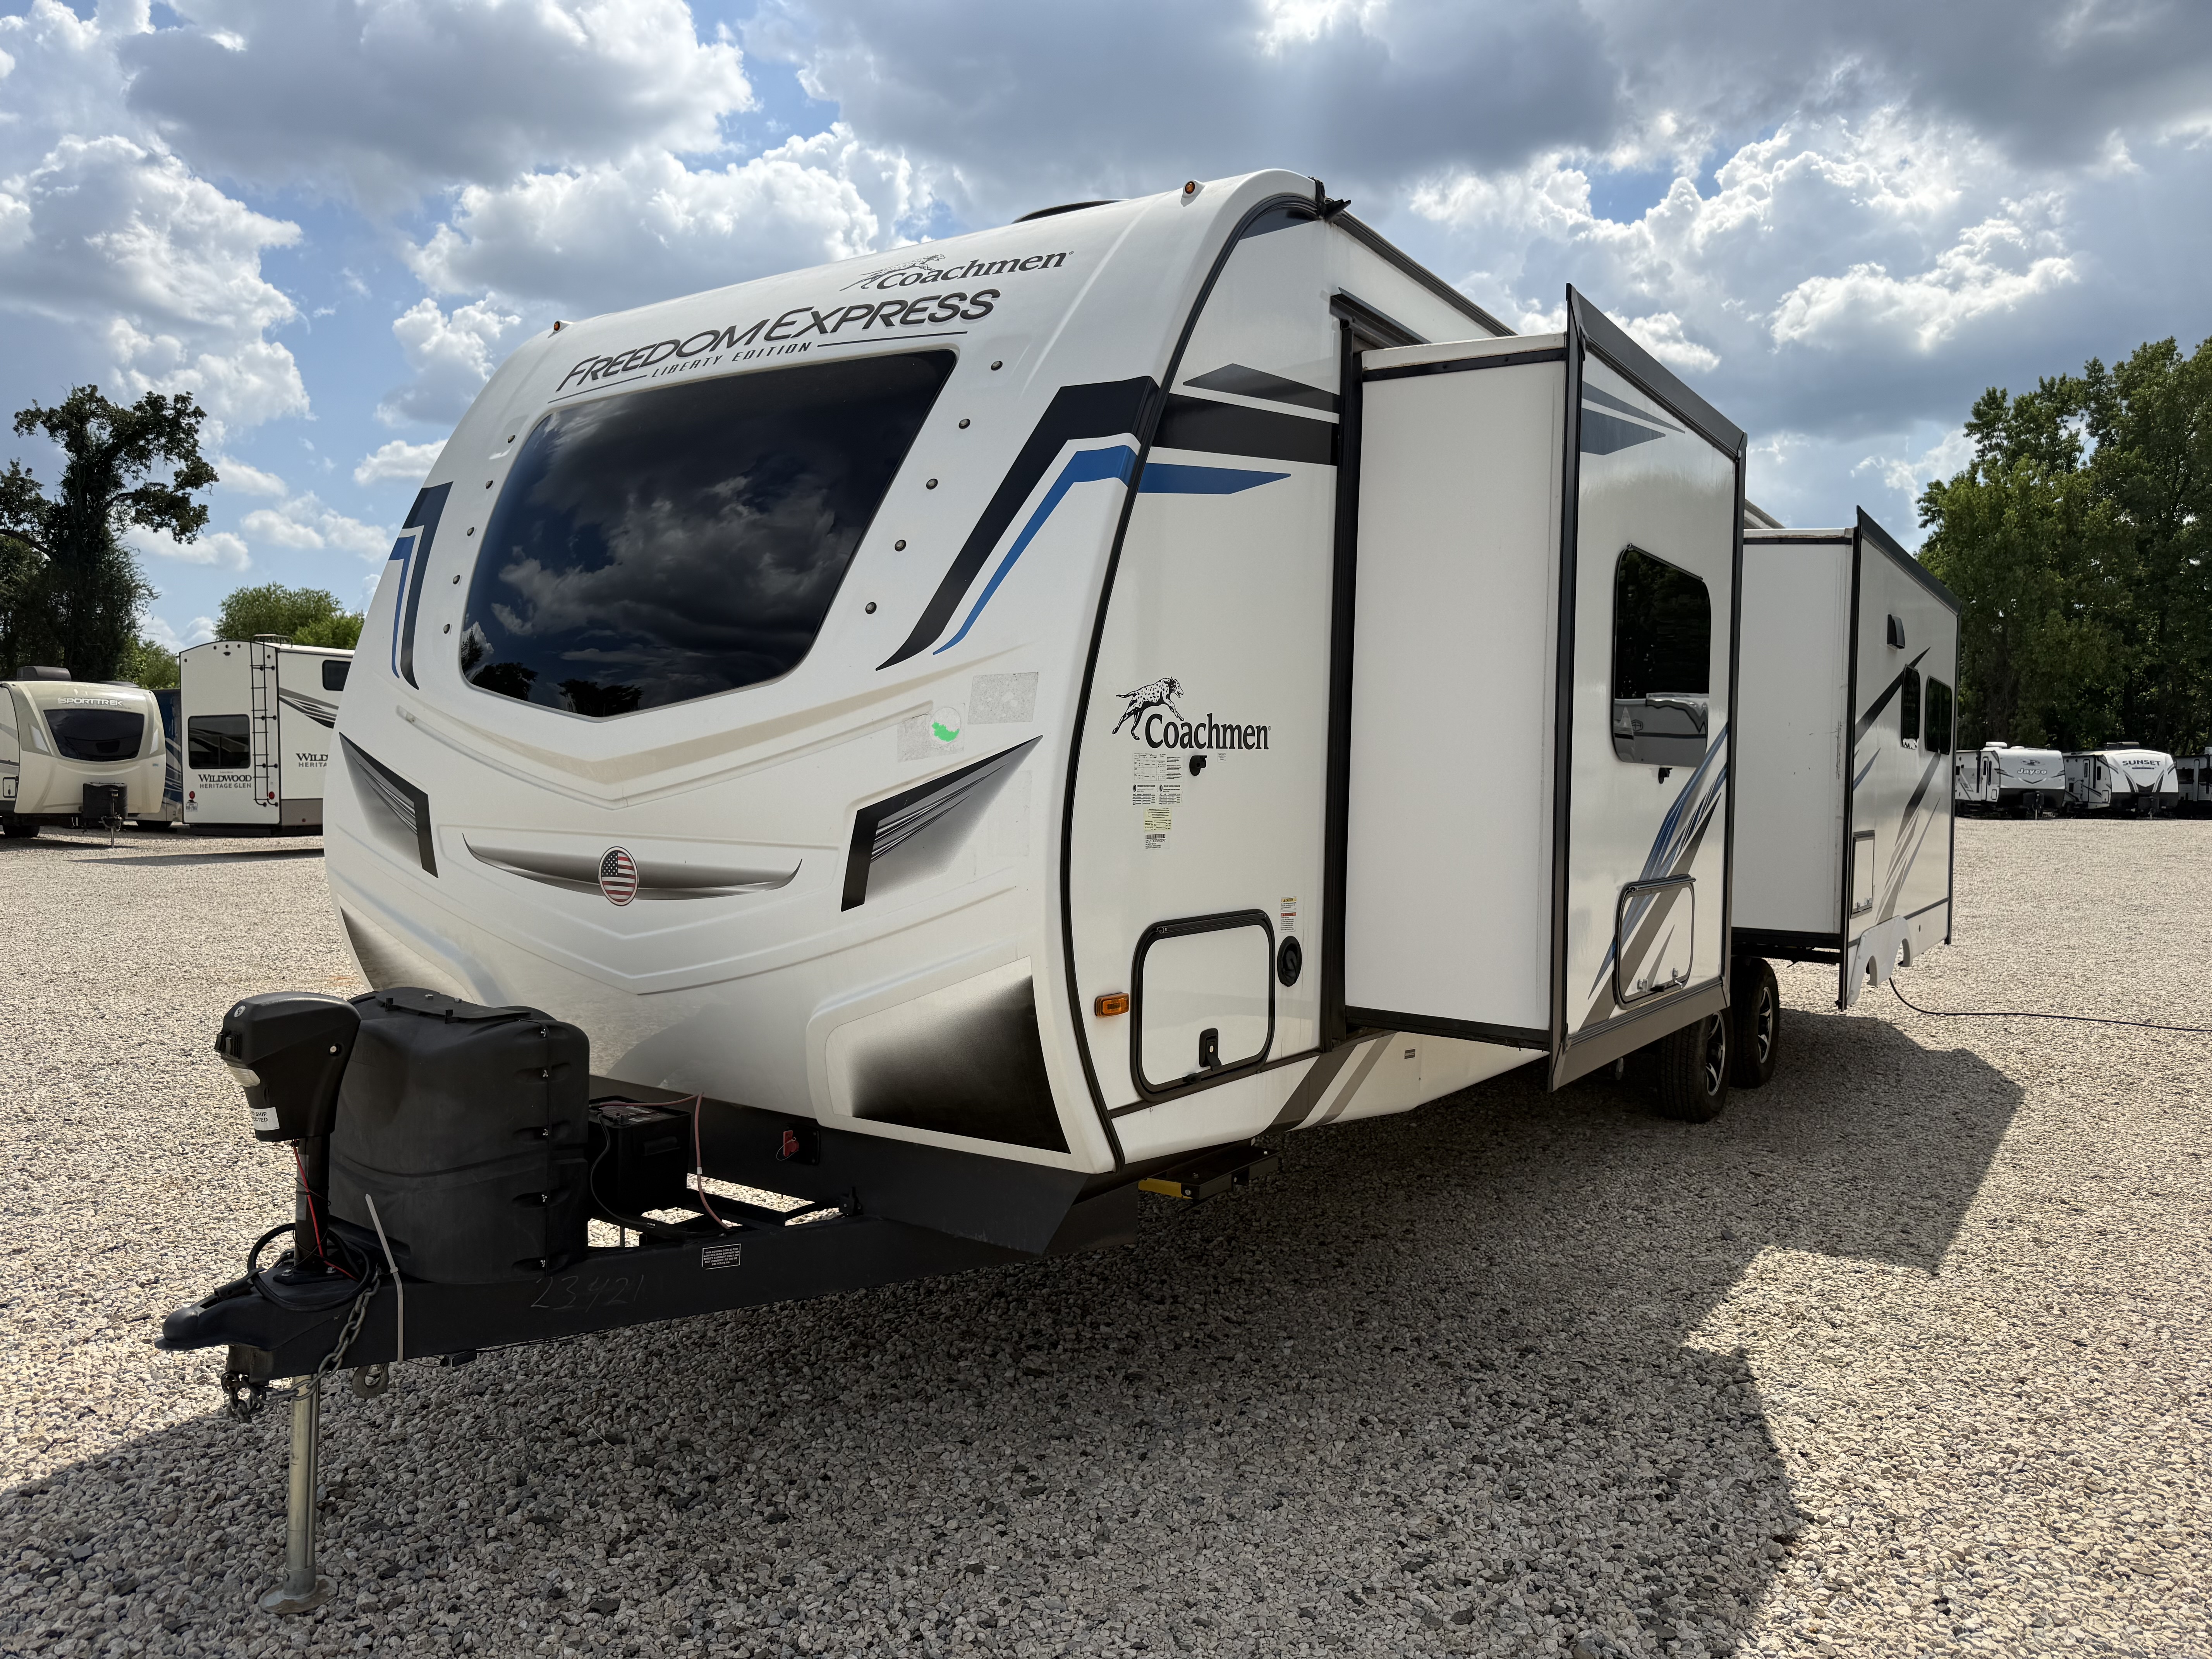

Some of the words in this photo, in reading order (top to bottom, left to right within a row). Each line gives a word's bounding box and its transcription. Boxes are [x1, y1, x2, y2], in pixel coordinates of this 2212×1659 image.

[876, 252, 1068, 289] Coachmen
[651, 355, 723, 378] LIBERTY
[732, 342, 812, 362] EDITION
[58, 697, 124, 706] SPORTTREK
[1145, 713, 1269, 750] Coachmen
[295, 753, 328, 761] WILD
[198, 774, 252, 782] WILDWOOD
[531, 1274, 644, 1313] 23421
